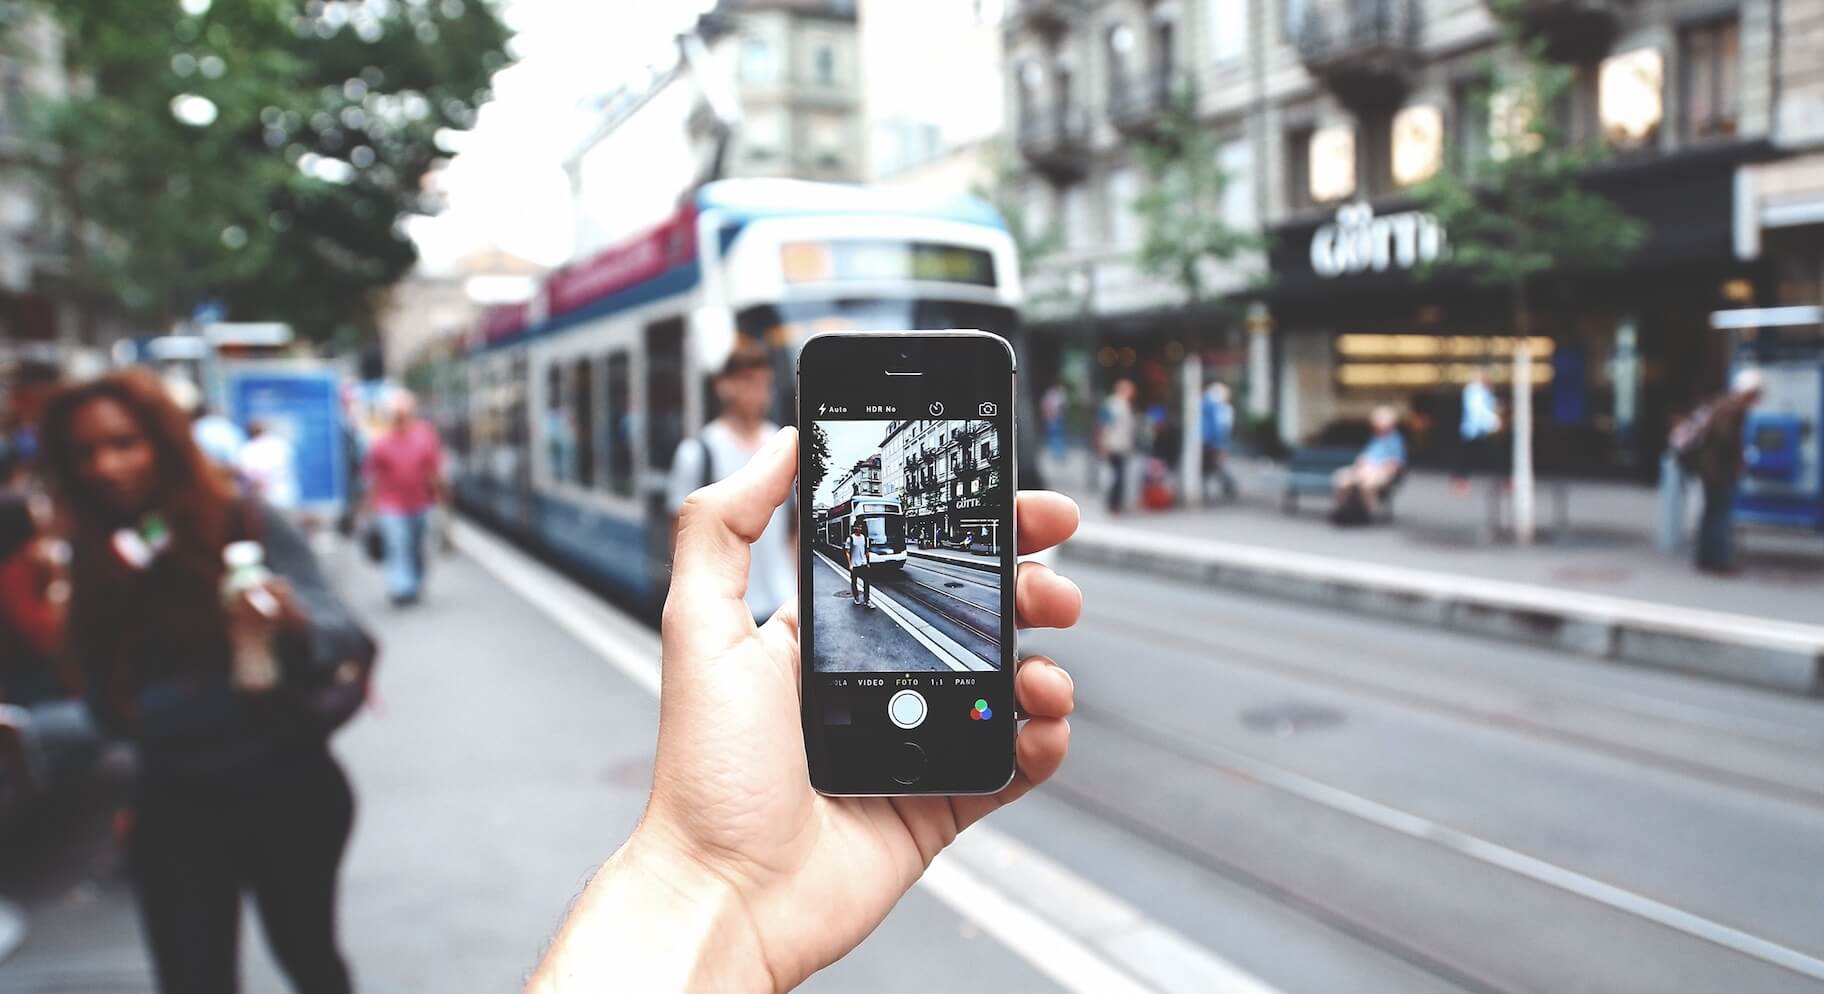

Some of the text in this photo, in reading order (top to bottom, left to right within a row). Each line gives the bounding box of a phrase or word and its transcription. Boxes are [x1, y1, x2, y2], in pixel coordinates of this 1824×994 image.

[866, 405, 896, 413] HDR No
[858, 679, 884, 687] VIDEO
[955, 678, 976, 686] PANO
